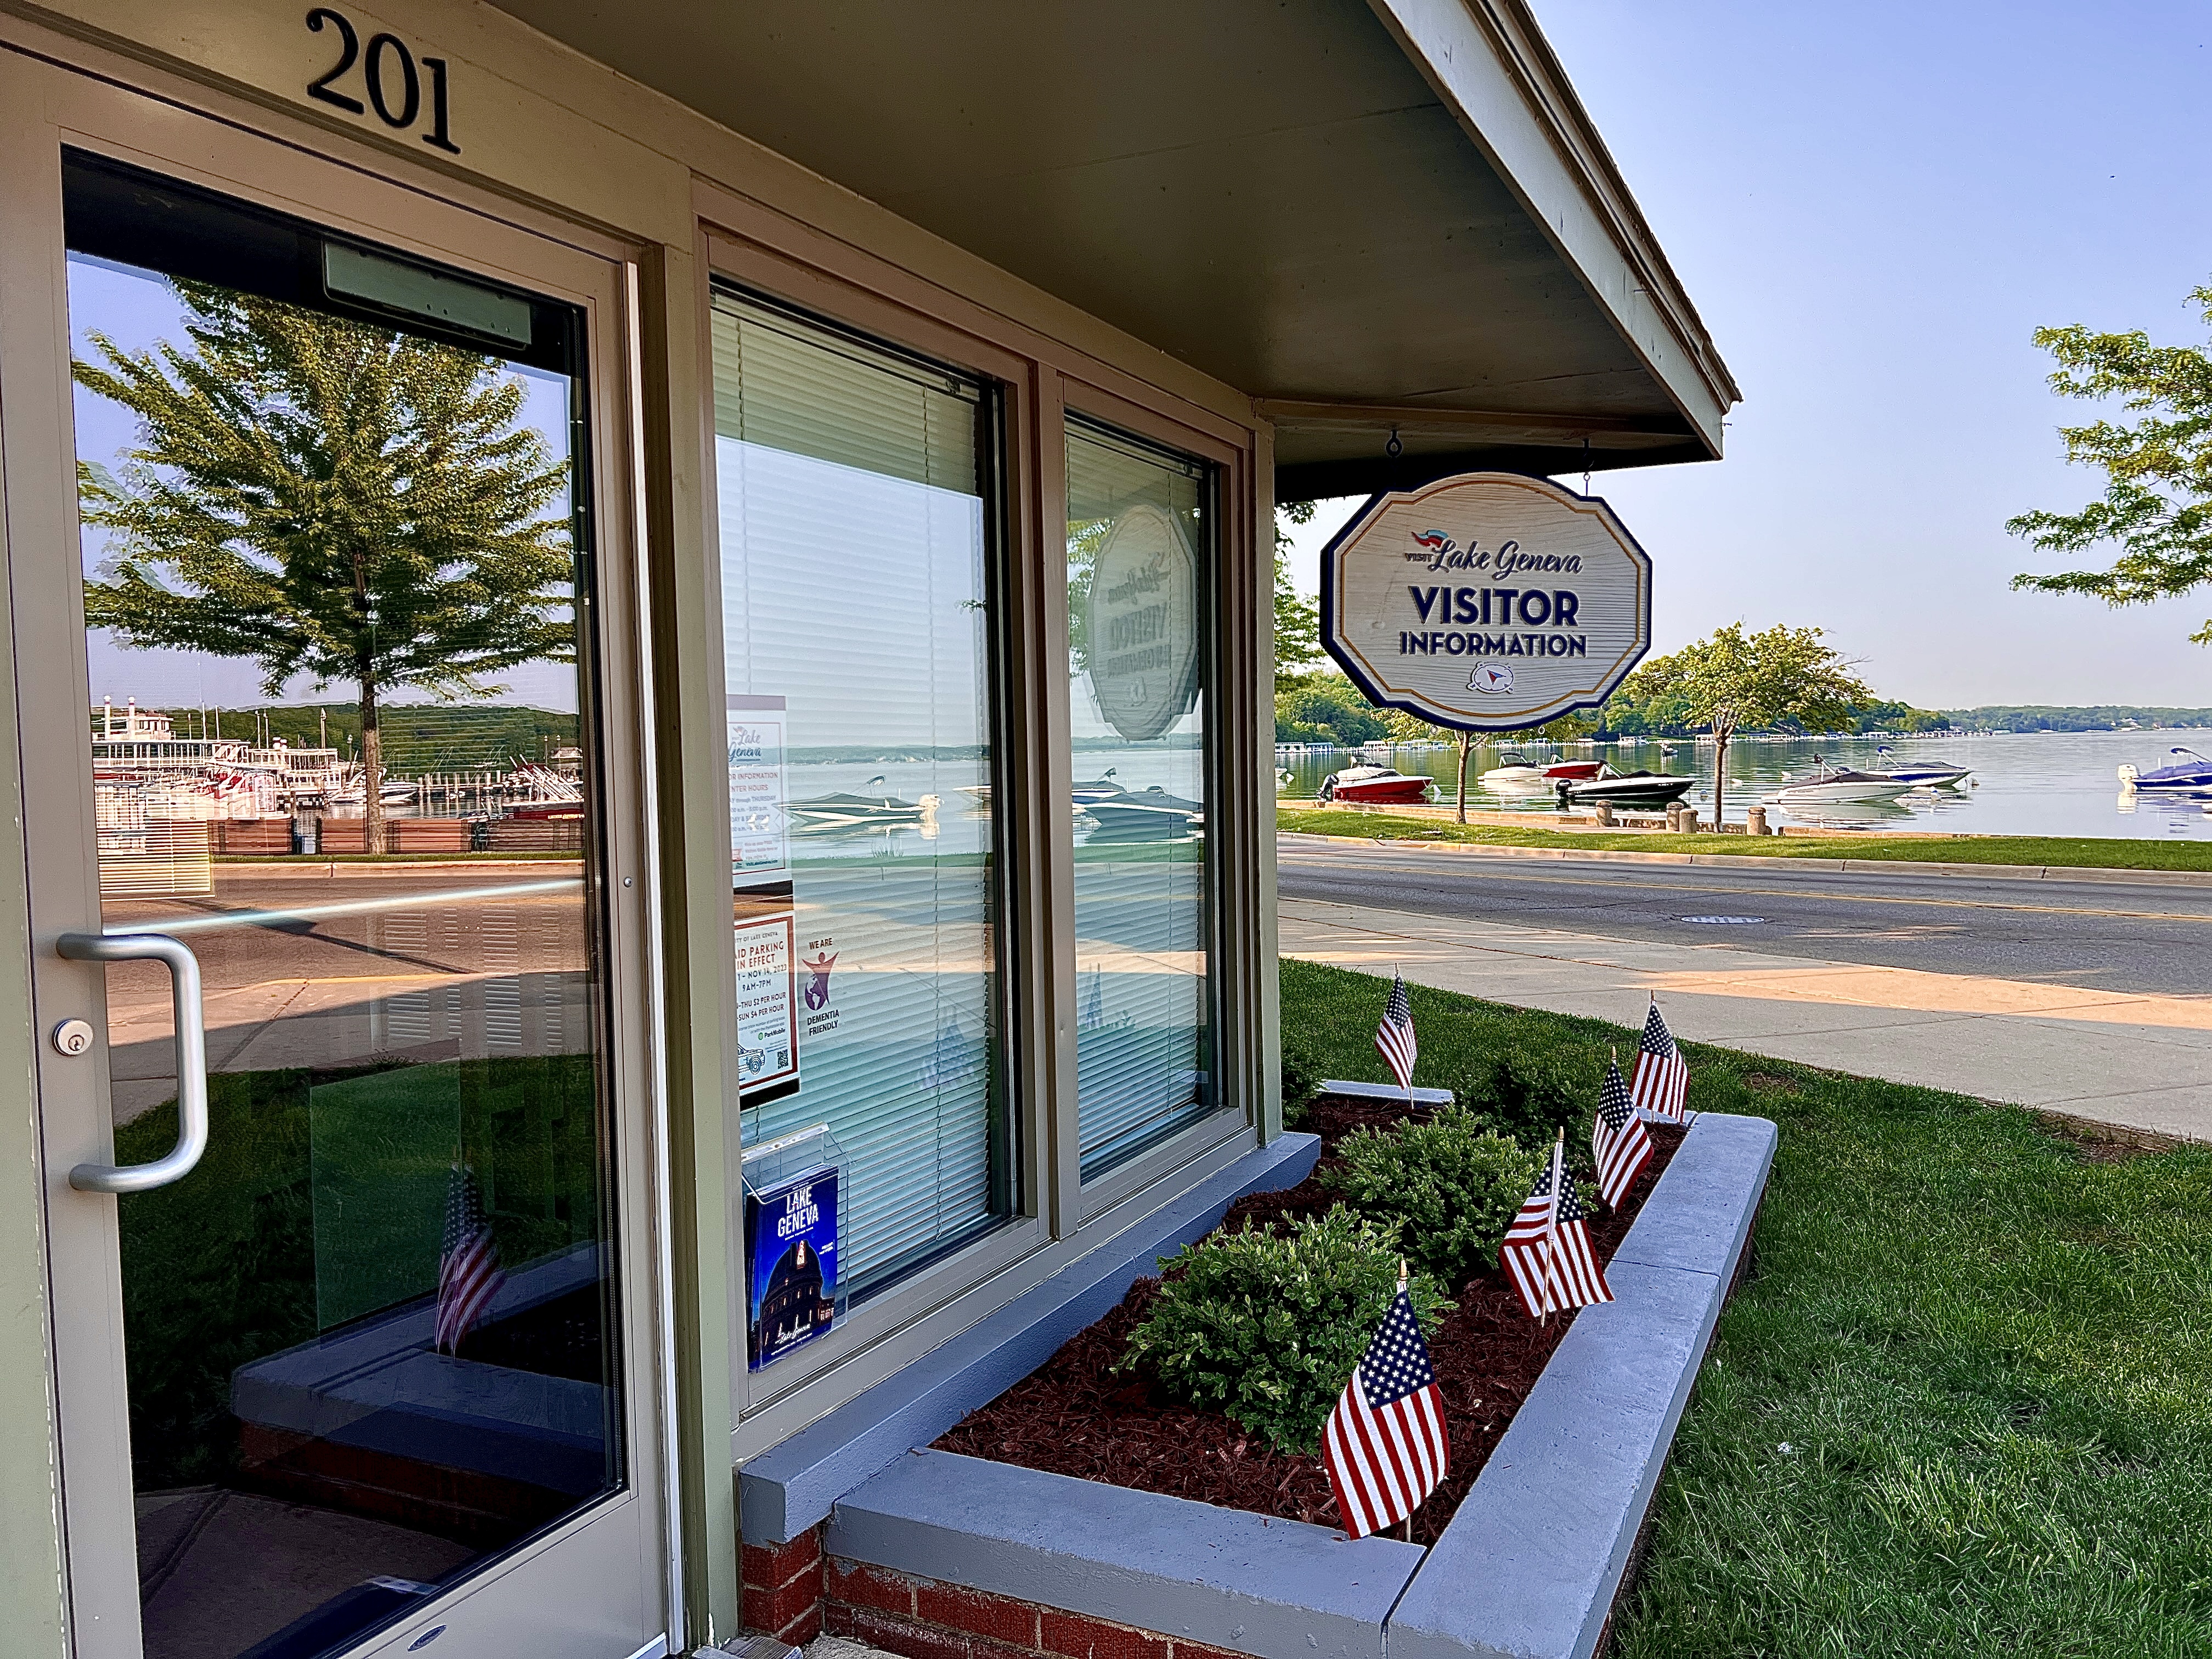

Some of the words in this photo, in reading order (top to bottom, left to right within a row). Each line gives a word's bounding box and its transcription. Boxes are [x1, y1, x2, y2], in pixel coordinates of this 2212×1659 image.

[306, 8, 461, 154] 201
[1405, 553, 1432, 562] VISIT
[1428, 540, 1489, 572] Lake
[1492, 540, 1583, 580] Geneva
[1408, 586, 1579, 626] VISITOR
[1400, 631, 1587, 658] INFORMATION
[738, 729, 761, 746] Lake
[729, 742, 761, 763] Geneva
[750, 941, 784, 956] PARKING
[809, 940, 819, 950] WE
[820, 938, 833, 948] ARE
[737, 960, 746, 970] IN
[749, 953, 775, 968] EFFECT
[748, 969, 762, 979] NOV
[764, 966, 772, 975] 14,
[774, 963, 787, 973] 2023
[742, 979, 771, 992] 9AM-7PM
[737, 1000, 752, 1009] -THU
[761, 996, 770, 1004] PER
[771, 992, 786, 1001] HOUR
[759, 1008, 768, 1016] PER
[769, 1004, 785, 1014] HOUR
[807, 1009, 839, 1026] DEMENTIA
[809, 1020, 839, 1036] FRIENDLY
[786, 1186, 812, 1215] LAKE
[777, 1204, 820, 1238] GENEVA
